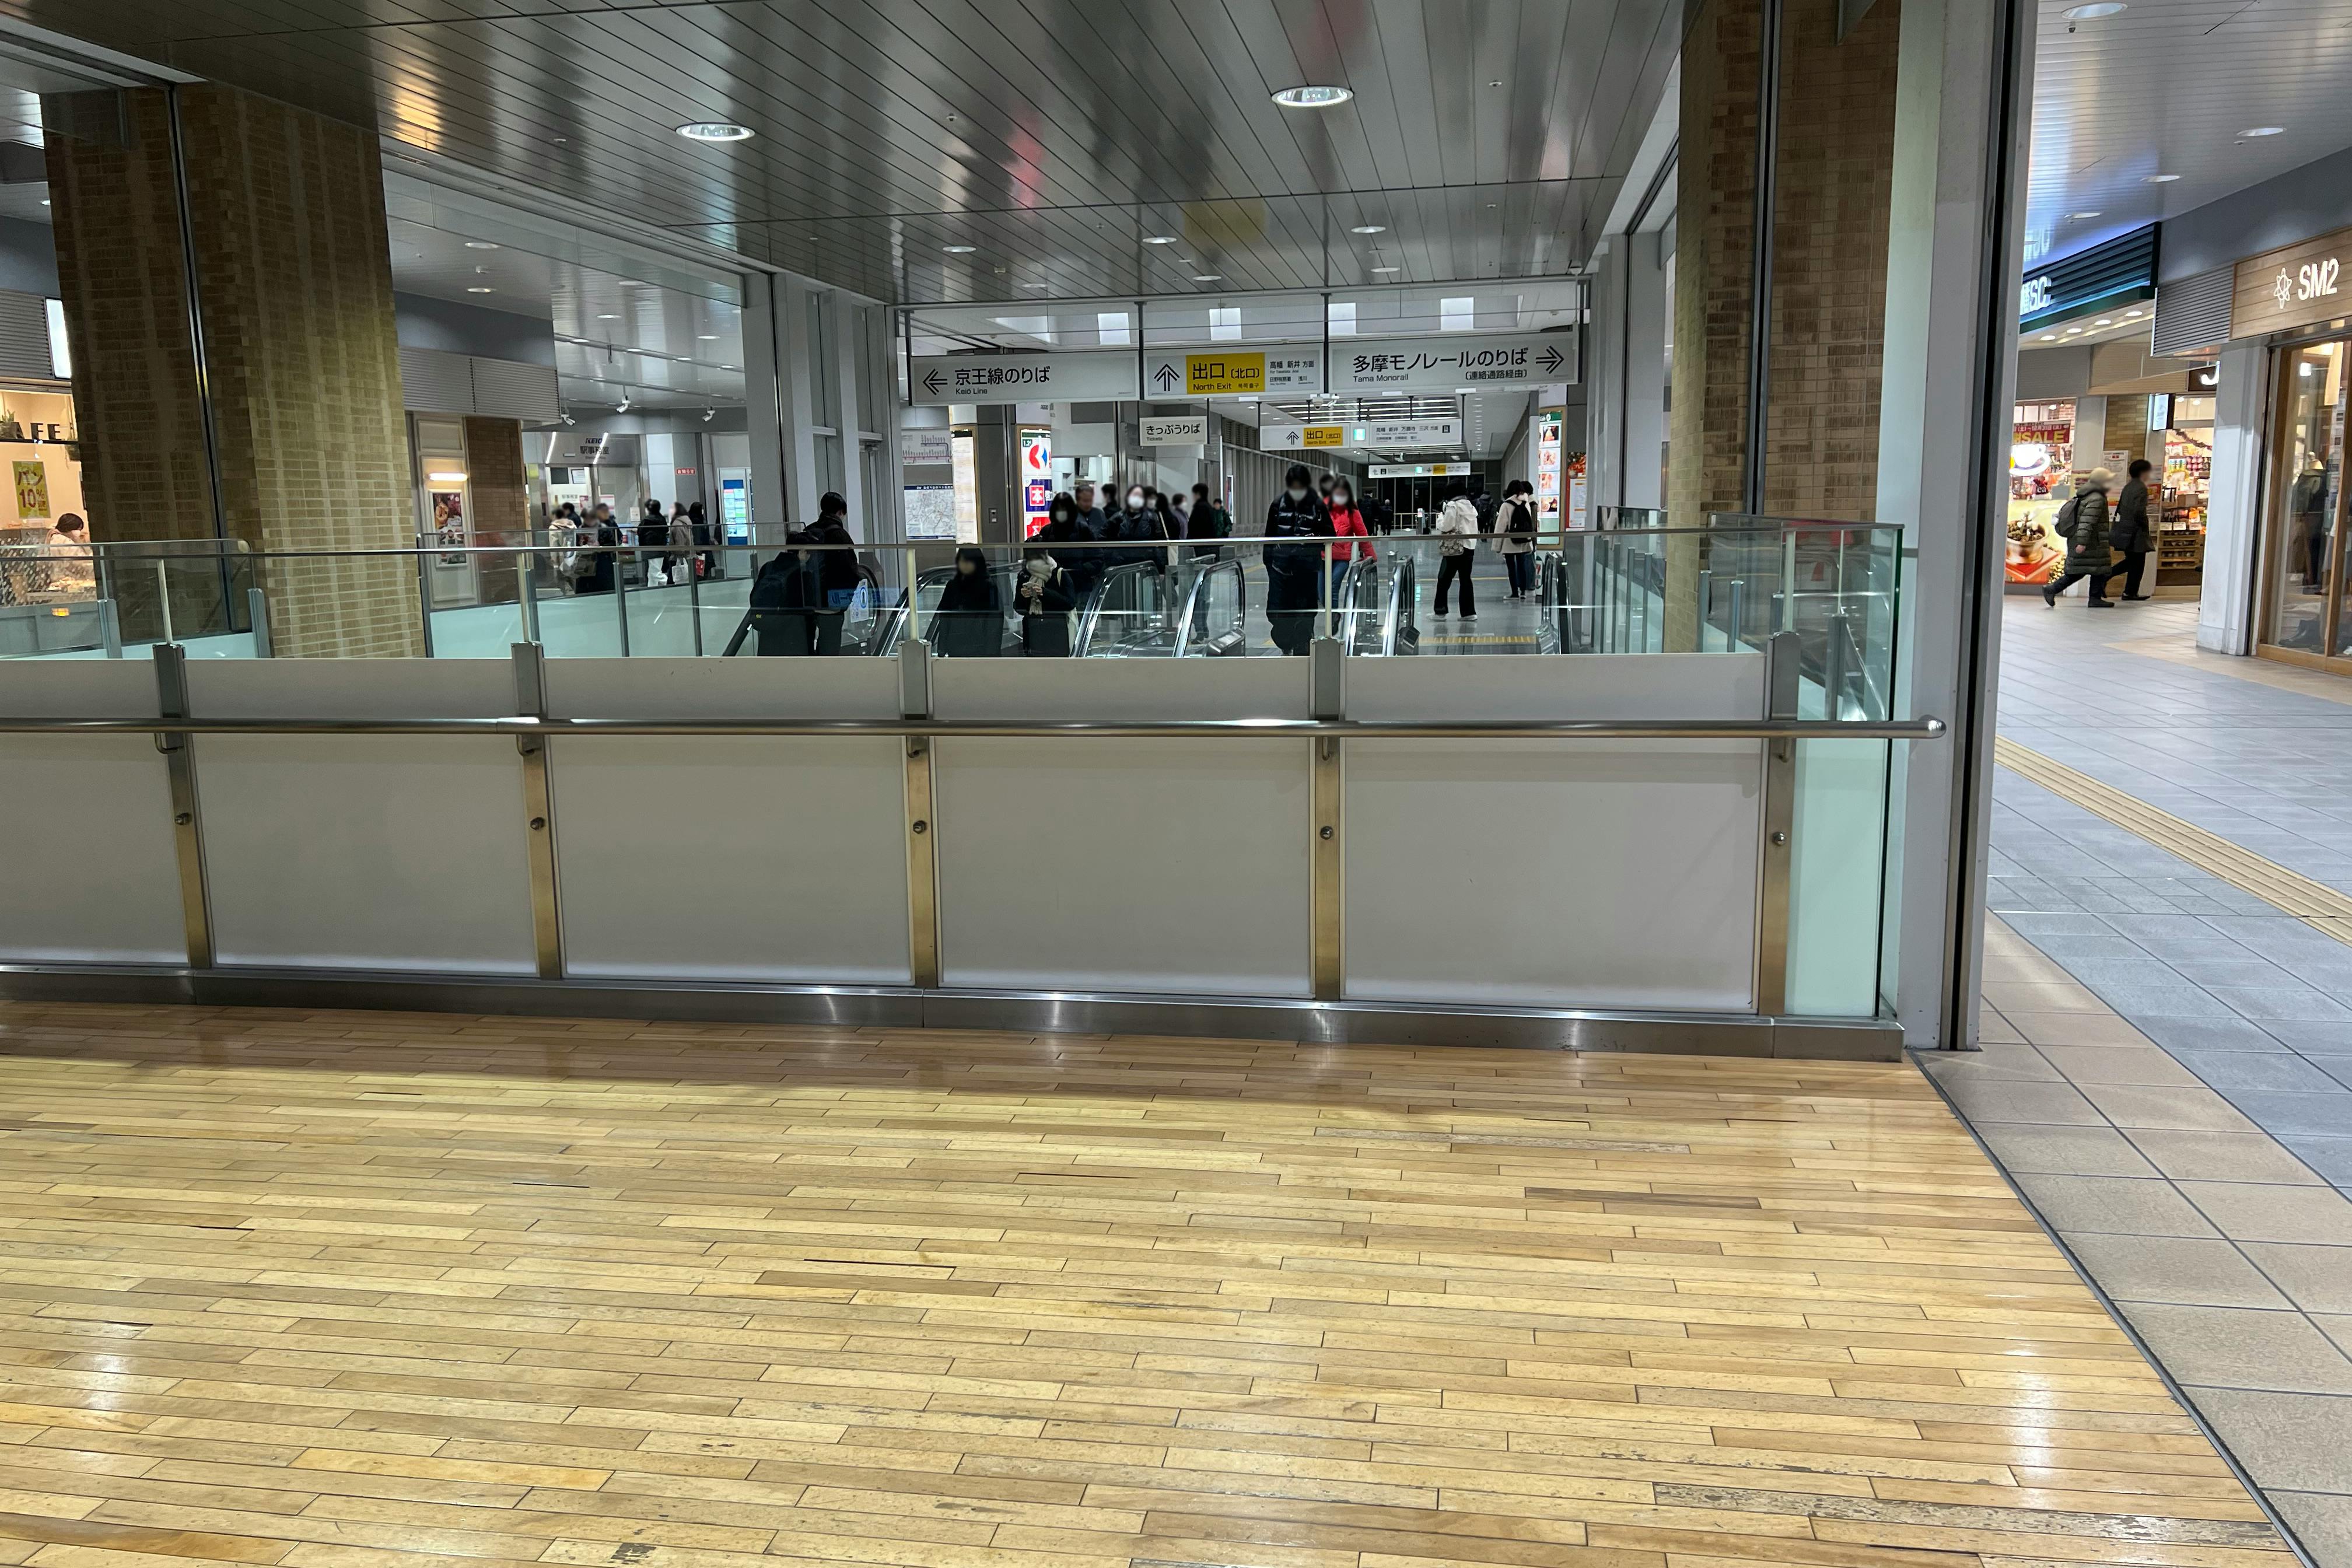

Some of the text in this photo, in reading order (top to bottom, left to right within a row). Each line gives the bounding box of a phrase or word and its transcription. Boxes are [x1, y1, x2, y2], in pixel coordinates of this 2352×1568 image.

[2298, 258, 2339, 300] SM2
[1353, 347, 1528, 373] 多摩モノレールのりば
[954, 366, 1051, 386] 京王線のりば
[1193, 363, 1224, 380] 出口
[12, 422, 62, 440] AFE
[1146, 424, 1200, 435] きっぷうりば
[1307, 430, 1323, 439] 出口
[1031, 488, 1044, 503] 本
